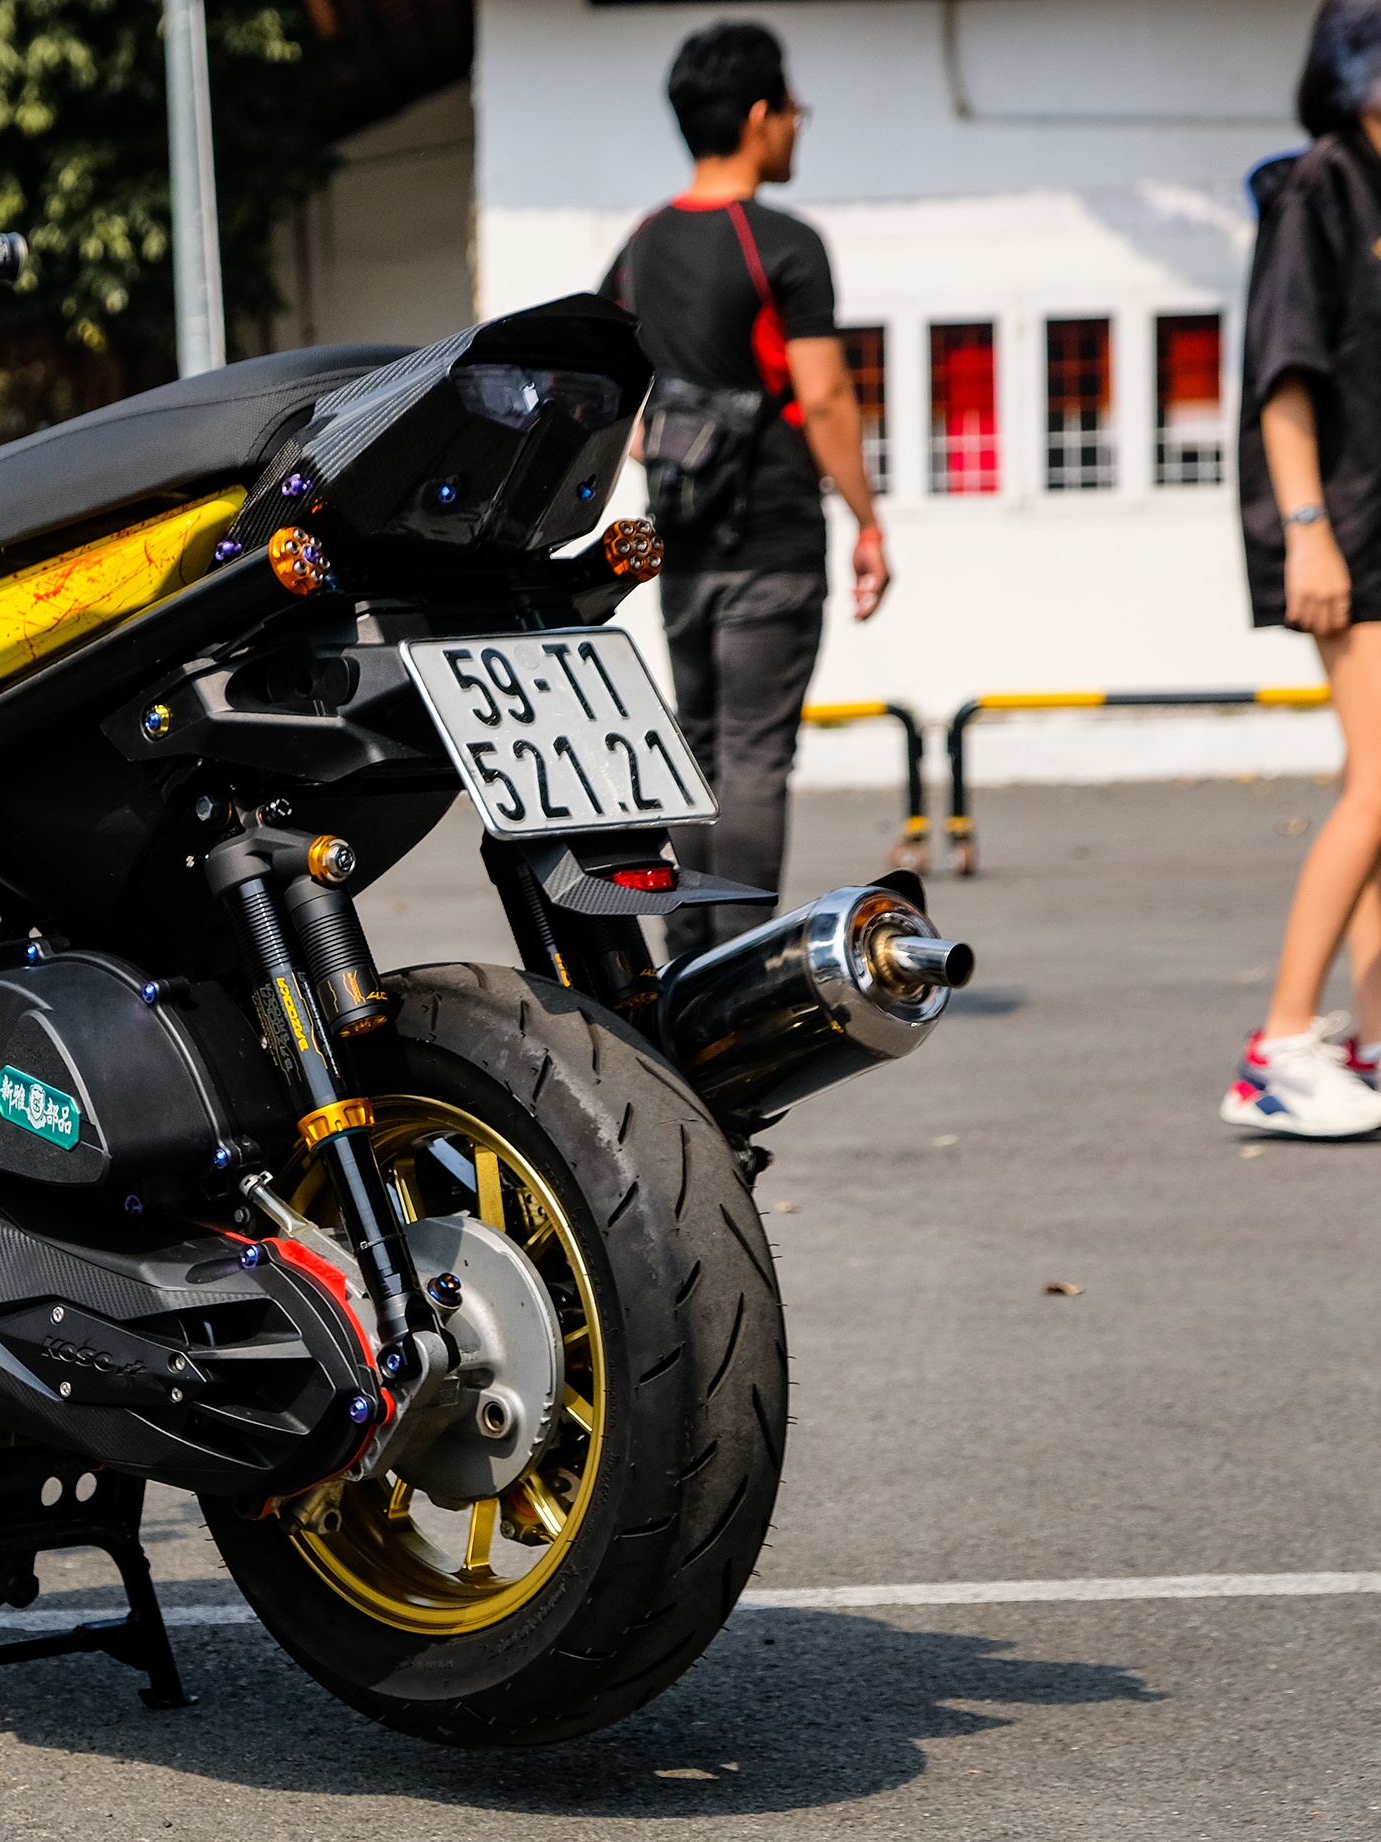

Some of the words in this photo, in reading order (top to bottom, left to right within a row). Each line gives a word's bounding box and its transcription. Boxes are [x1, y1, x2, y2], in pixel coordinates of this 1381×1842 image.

[442, 640, 629, 727] 59-T1
[465, 728, 696, 822] 521.21
[276, 977, 309, 1052] BAZOOKA
[41, 1334, 113, 1373] KOSO
